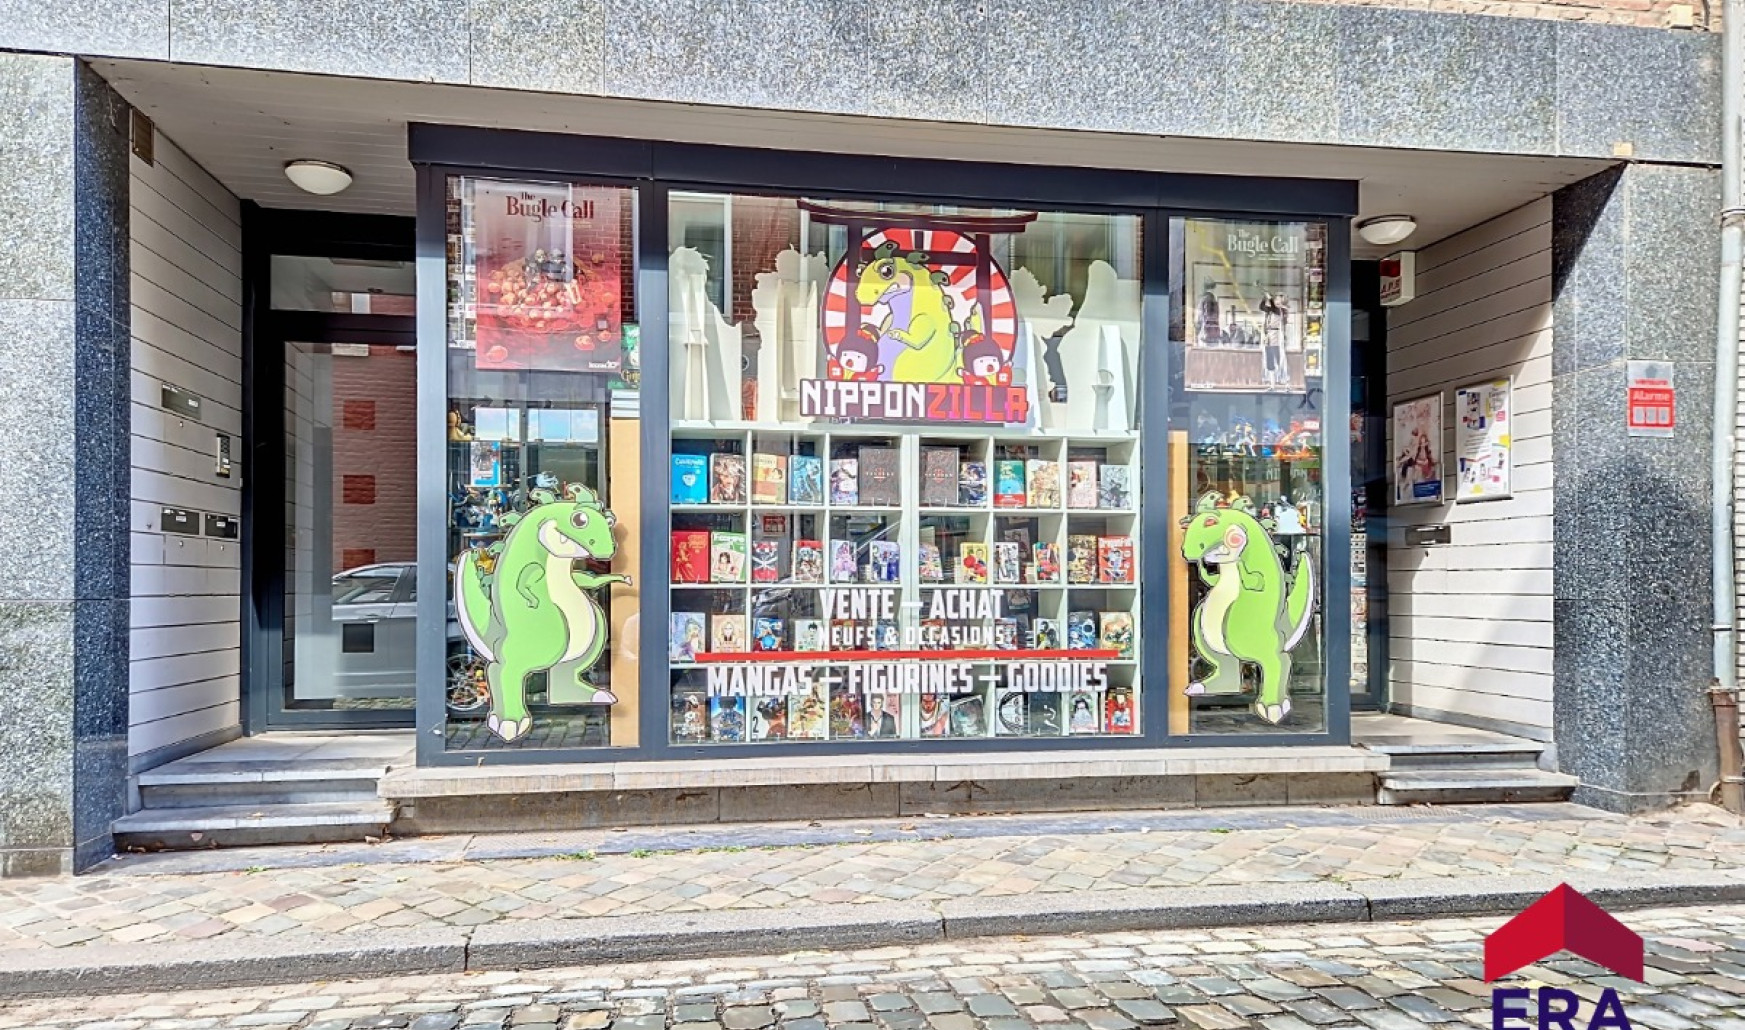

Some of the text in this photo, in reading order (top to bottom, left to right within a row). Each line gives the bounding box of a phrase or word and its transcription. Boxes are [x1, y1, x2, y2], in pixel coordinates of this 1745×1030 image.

[521, 191, 536, 200] The
[506, 195, 594, 222] Bugle Call
[1228, 234, 1298, 257] Bugle Call
[801, 379, 1027, 422] NIPPONZILLA
[1633, 390, 1670, 401] Alarme
[819, 589, 894, 619] VENTE
[929, 589, 1004, 619] ACHAT
[819, 626, 1004, 646] NEUFS & OCCASIONS
[707, 665, 812, 697] MANGAS
[849, 663, 973, 694] FIGURINES
[1007, 662, 1107, 693] GOODIES
